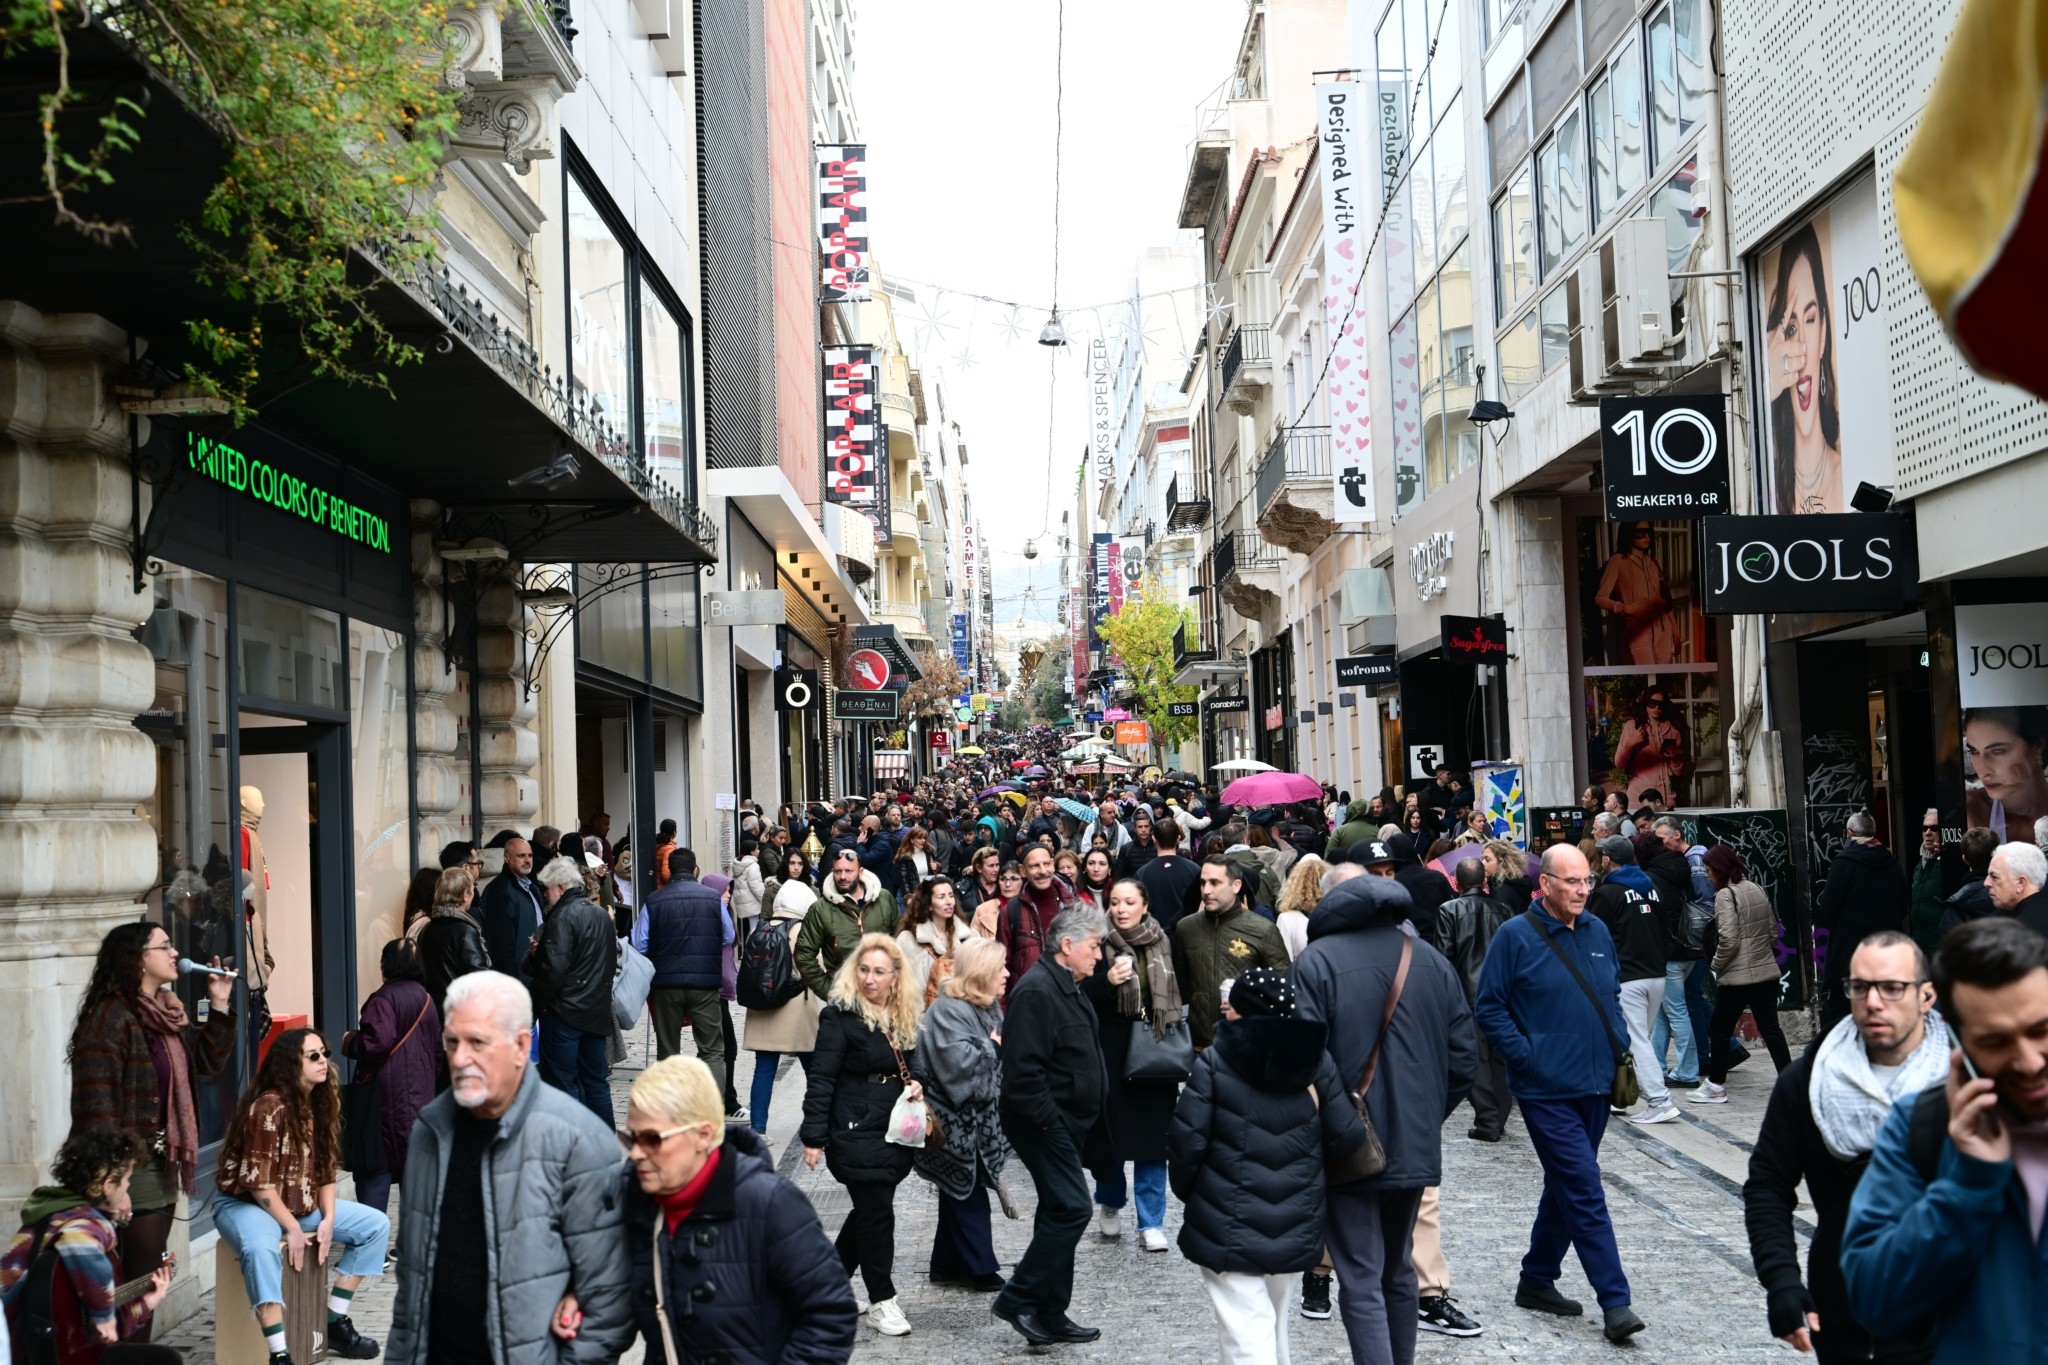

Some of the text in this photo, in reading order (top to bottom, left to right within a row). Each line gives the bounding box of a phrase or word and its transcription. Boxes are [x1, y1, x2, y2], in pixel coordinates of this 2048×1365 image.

[1324, 93, 1352, 182] Designed
[828, 156, 861, 291] POP-AIR
[1094, 338, 1109, 416] SPENCER
[833, 358, 866, 494] POP-AIR
[1096, 419, 1109, 430] &
[1611, 408, 1718, 476] 10
[188, 431, 248, 491] UNITED
[250, 460, 308, 518] COLORS
[310, 487, 328, 525] OF
[1616, 493, 1718, 508] SNEAKER10.GR
[1715, 537, 1893, 595] JOOLS
[1341, 664, 1391, 677] sofronas
[1450, 636, 1505, 653] Sugarfree
[1173, 704, 1193, 715] BSB
[1941, 827, 1962, 845] JOOLS
